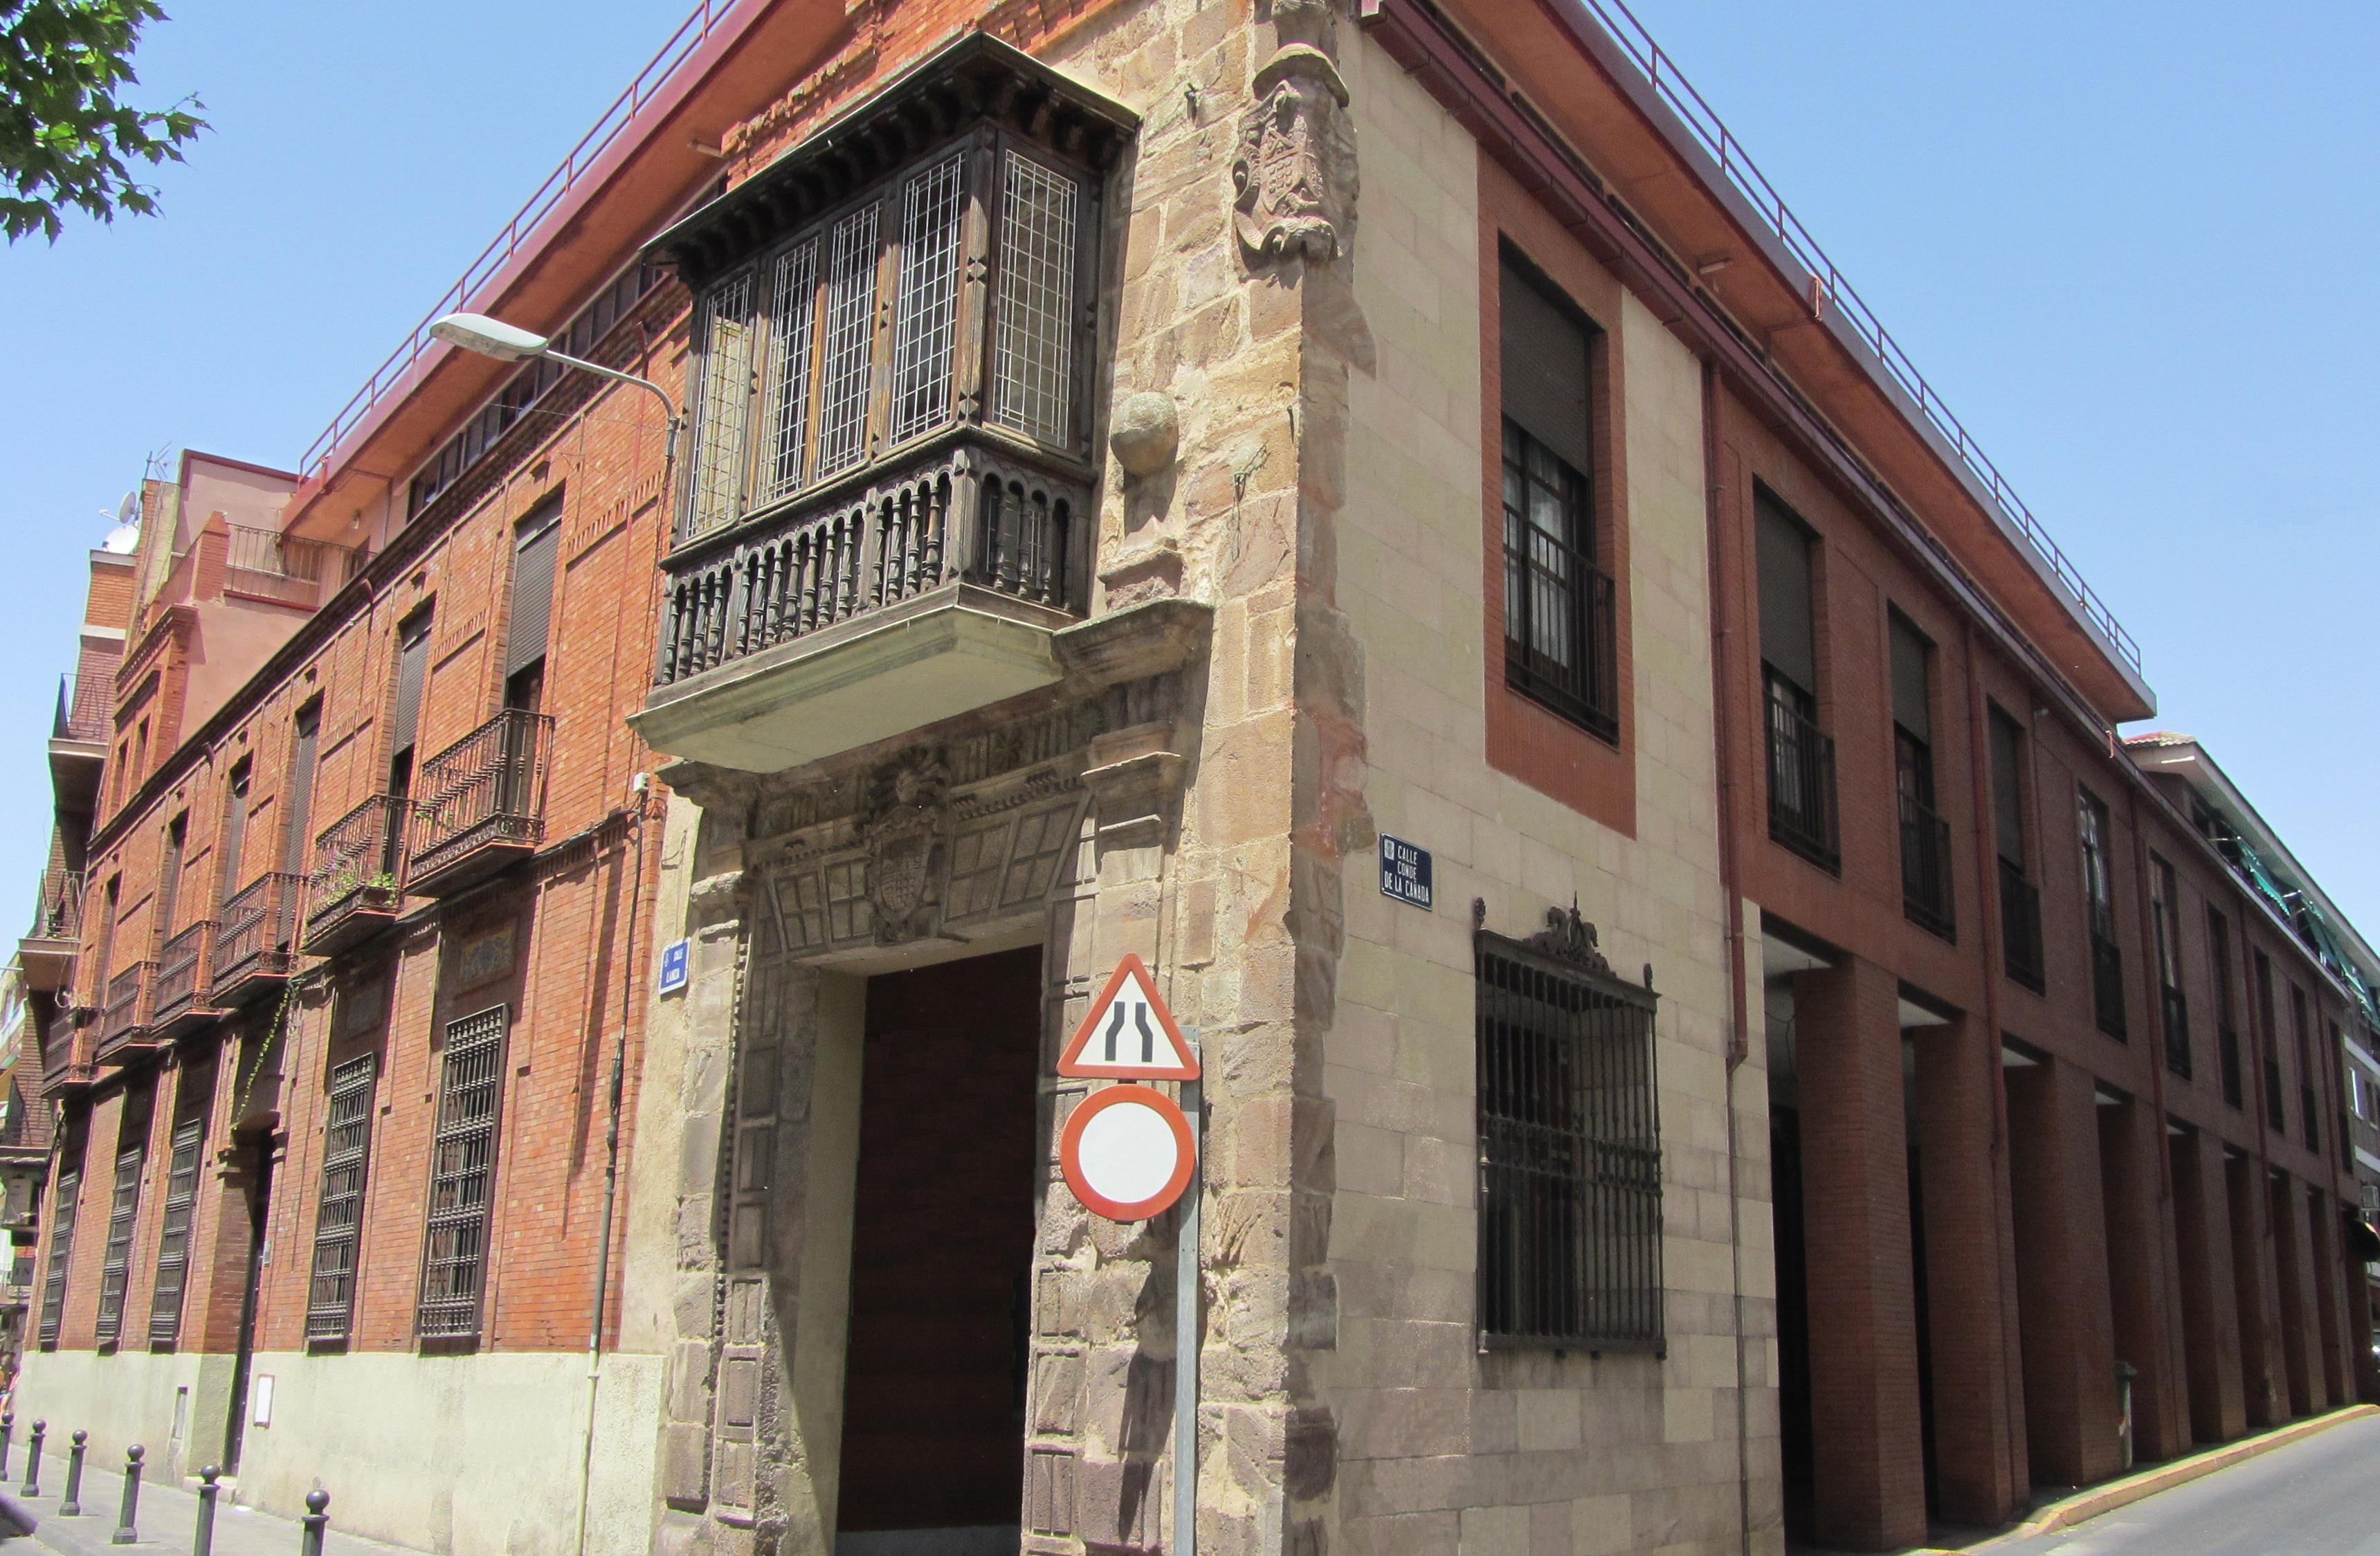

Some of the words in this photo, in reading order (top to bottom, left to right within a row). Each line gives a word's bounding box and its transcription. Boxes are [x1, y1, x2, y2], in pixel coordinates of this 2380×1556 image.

[1397, 846, 1417, 865] CALLE
[1397, 861, 1417, 880] CONDE
[1384, 871, 1392, 889] DE
[1395, 875, 1402, 893] LA
[1405, 880, 1429, 903] CAÑADA
